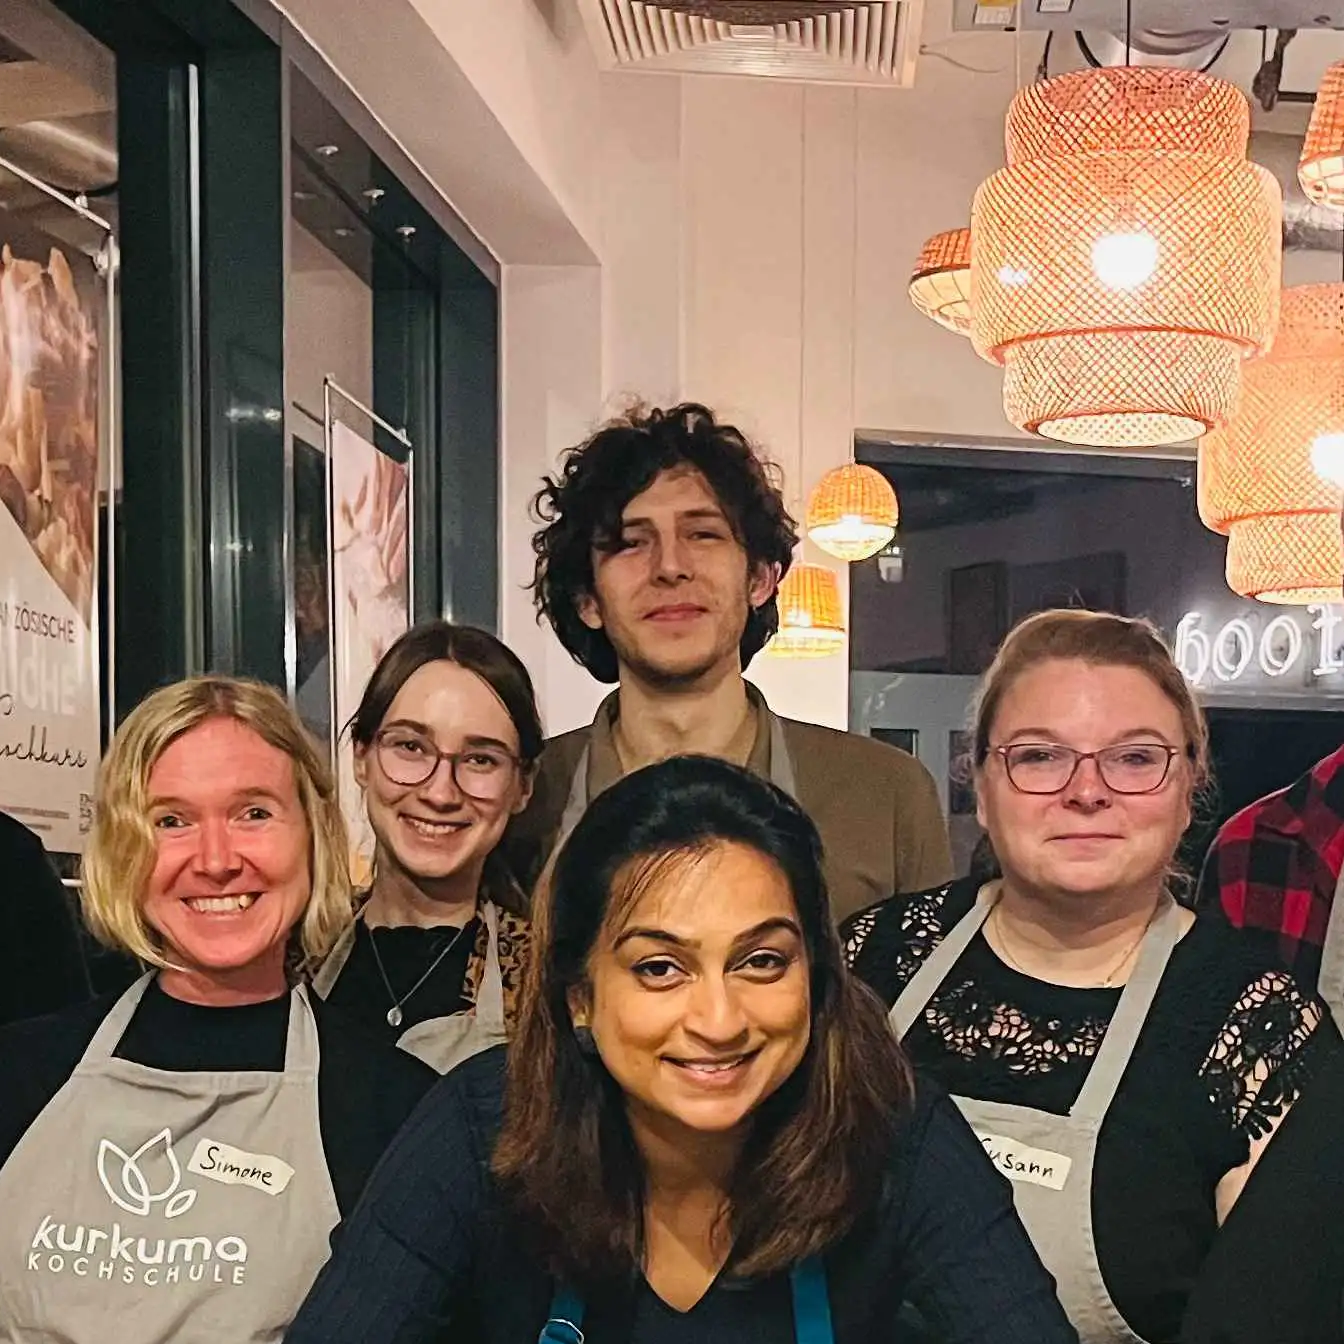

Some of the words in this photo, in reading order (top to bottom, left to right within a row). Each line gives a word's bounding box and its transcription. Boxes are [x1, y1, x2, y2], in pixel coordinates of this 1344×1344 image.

[199, 1146, 273, 1187] Simone
[31, 1215, 248, 1265] kurkuma
[27, 1252, 246, 1286] KOCHSCHULE
